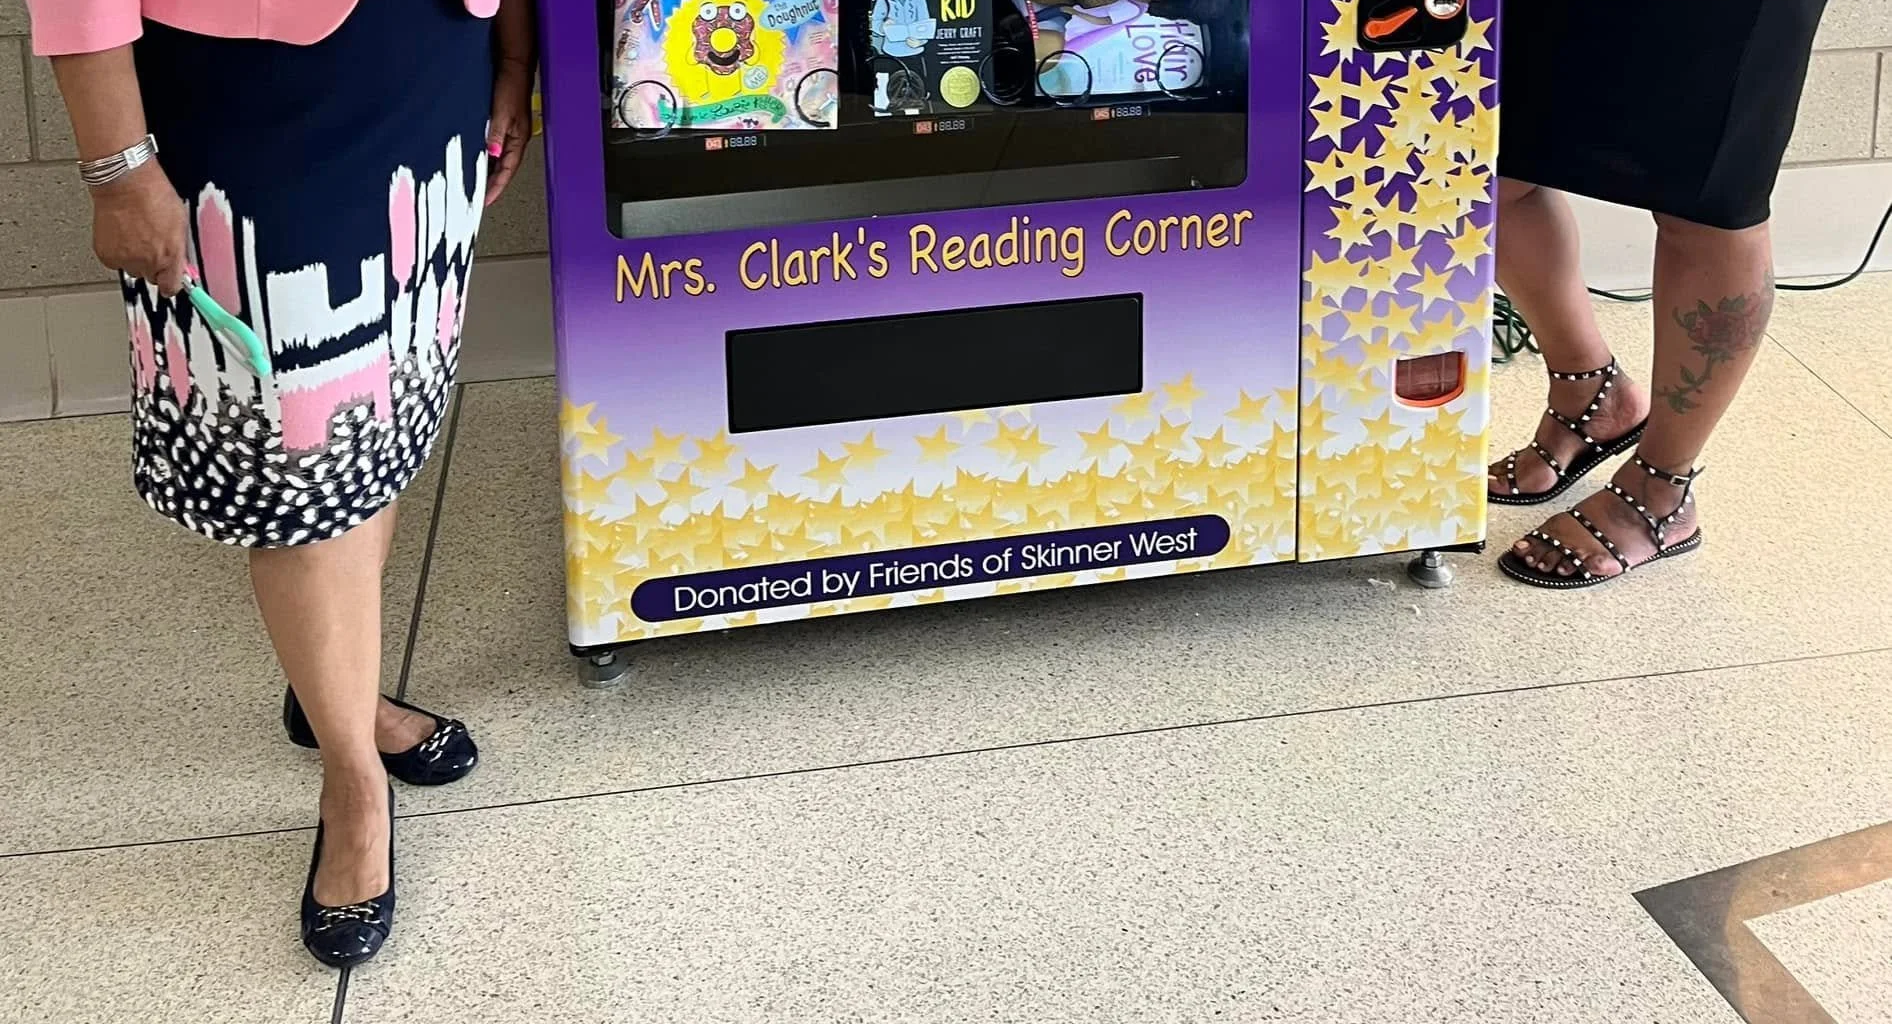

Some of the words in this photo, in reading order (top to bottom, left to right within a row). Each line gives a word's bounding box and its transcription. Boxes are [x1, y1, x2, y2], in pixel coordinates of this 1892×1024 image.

[936, 27, 958, 40] JERRY
[959, 26, 983, 39] CRAFT
[1125, 23, 1158, 84] Love
[1159, 21, 1195, 83] Hair
[615, 250, 717, 303] Mrs.
[738, 226, 890, 291] Clark's
[908, 216, 1086, 278] Reading
[1104, 208, 1254, 259] Corner
[673, 573, 817, 613] Donated
[821, 568, 860, 605] by
[868, 552, 974, 590] Friends
[982, 547, 1014, 576] of
[1020, 539, 1122, 572] Skinner
[1128, 526, 1200, 558] West
